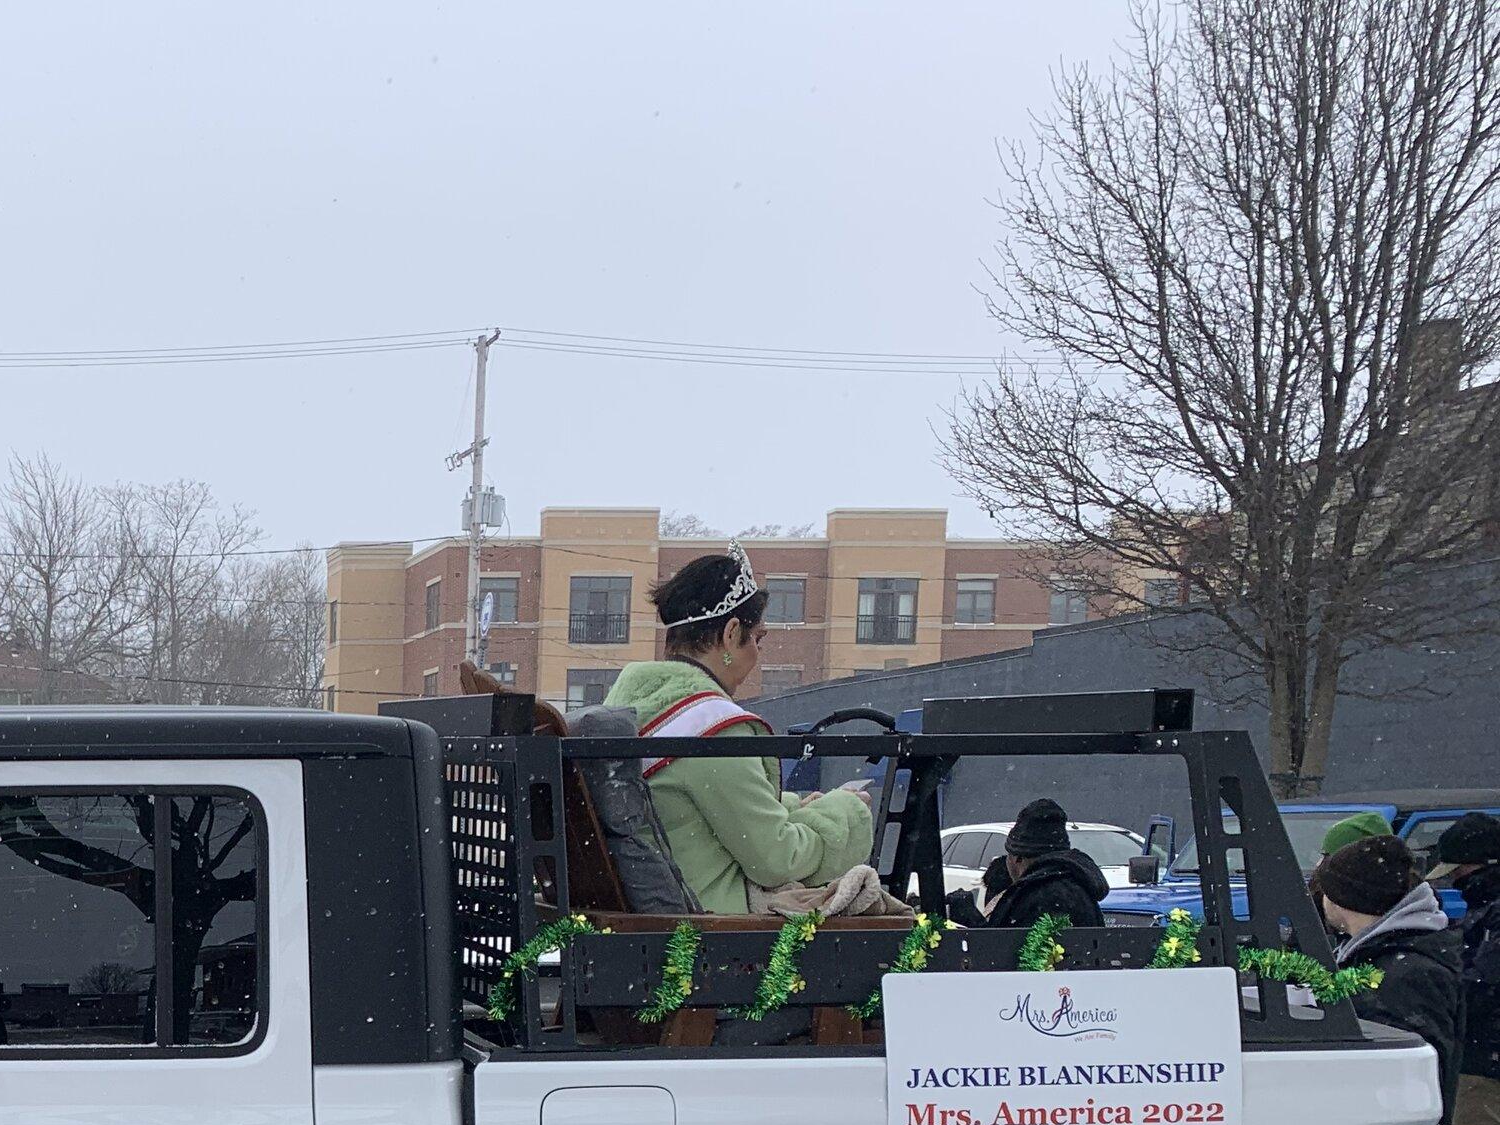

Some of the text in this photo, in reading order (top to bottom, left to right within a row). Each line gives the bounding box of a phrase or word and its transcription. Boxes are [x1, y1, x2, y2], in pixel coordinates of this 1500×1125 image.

[906, 1062, 1226, 1089] JACKIE BLANKENSHIP
[1142, 1102, 1225, 1124] 2022
